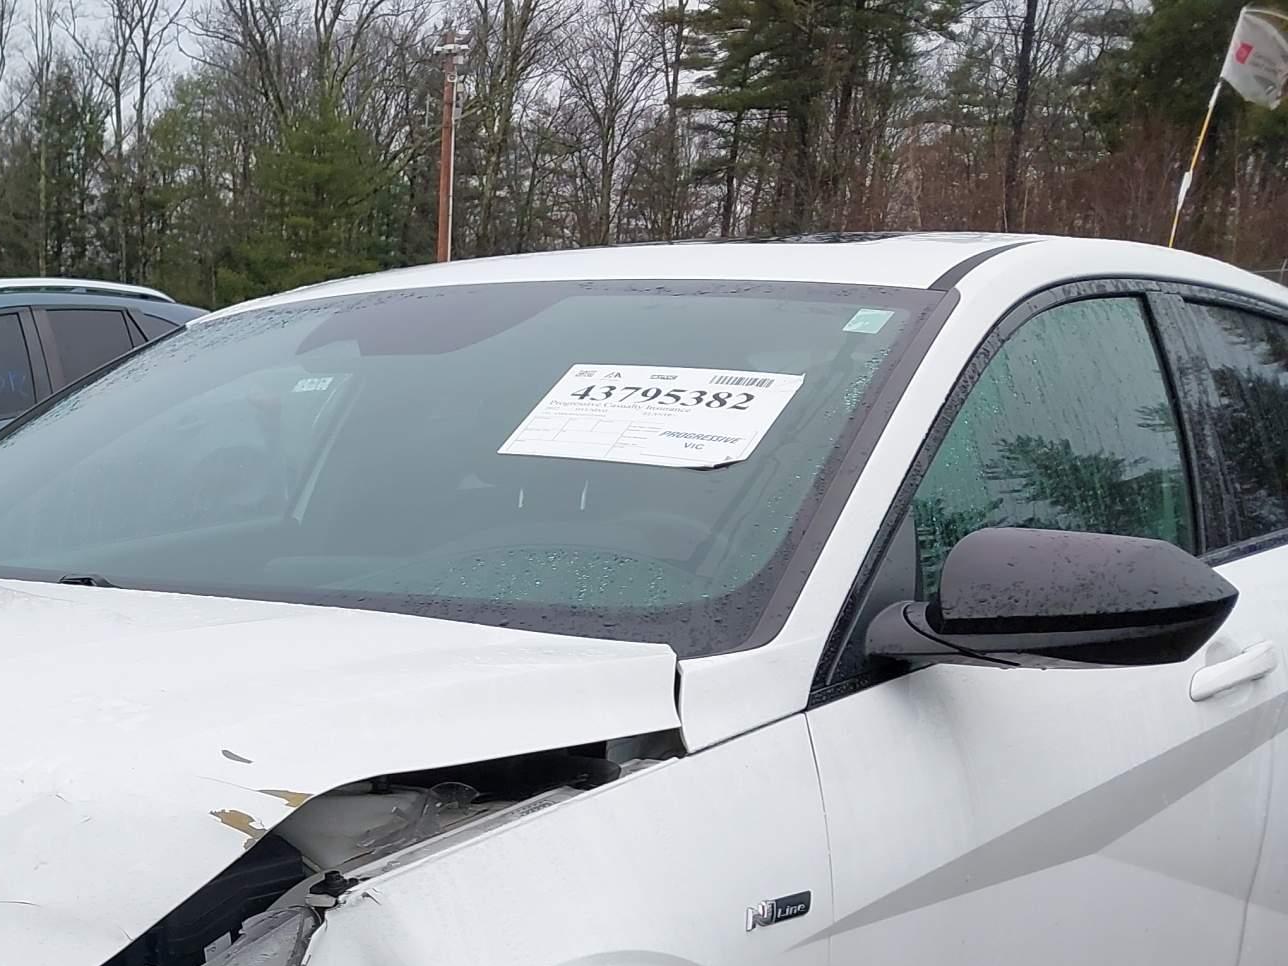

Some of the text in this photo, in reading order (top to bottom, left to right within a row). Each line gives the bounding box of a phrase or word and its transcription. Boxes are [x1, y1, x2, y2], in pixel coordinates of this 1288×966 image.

[571, 384, 755, 410] 43795382
[659, 430, 743, 444] PROGRESSIVE
[683, 442, 705, 450] VIC
[776, 903, 807, 919] Line
